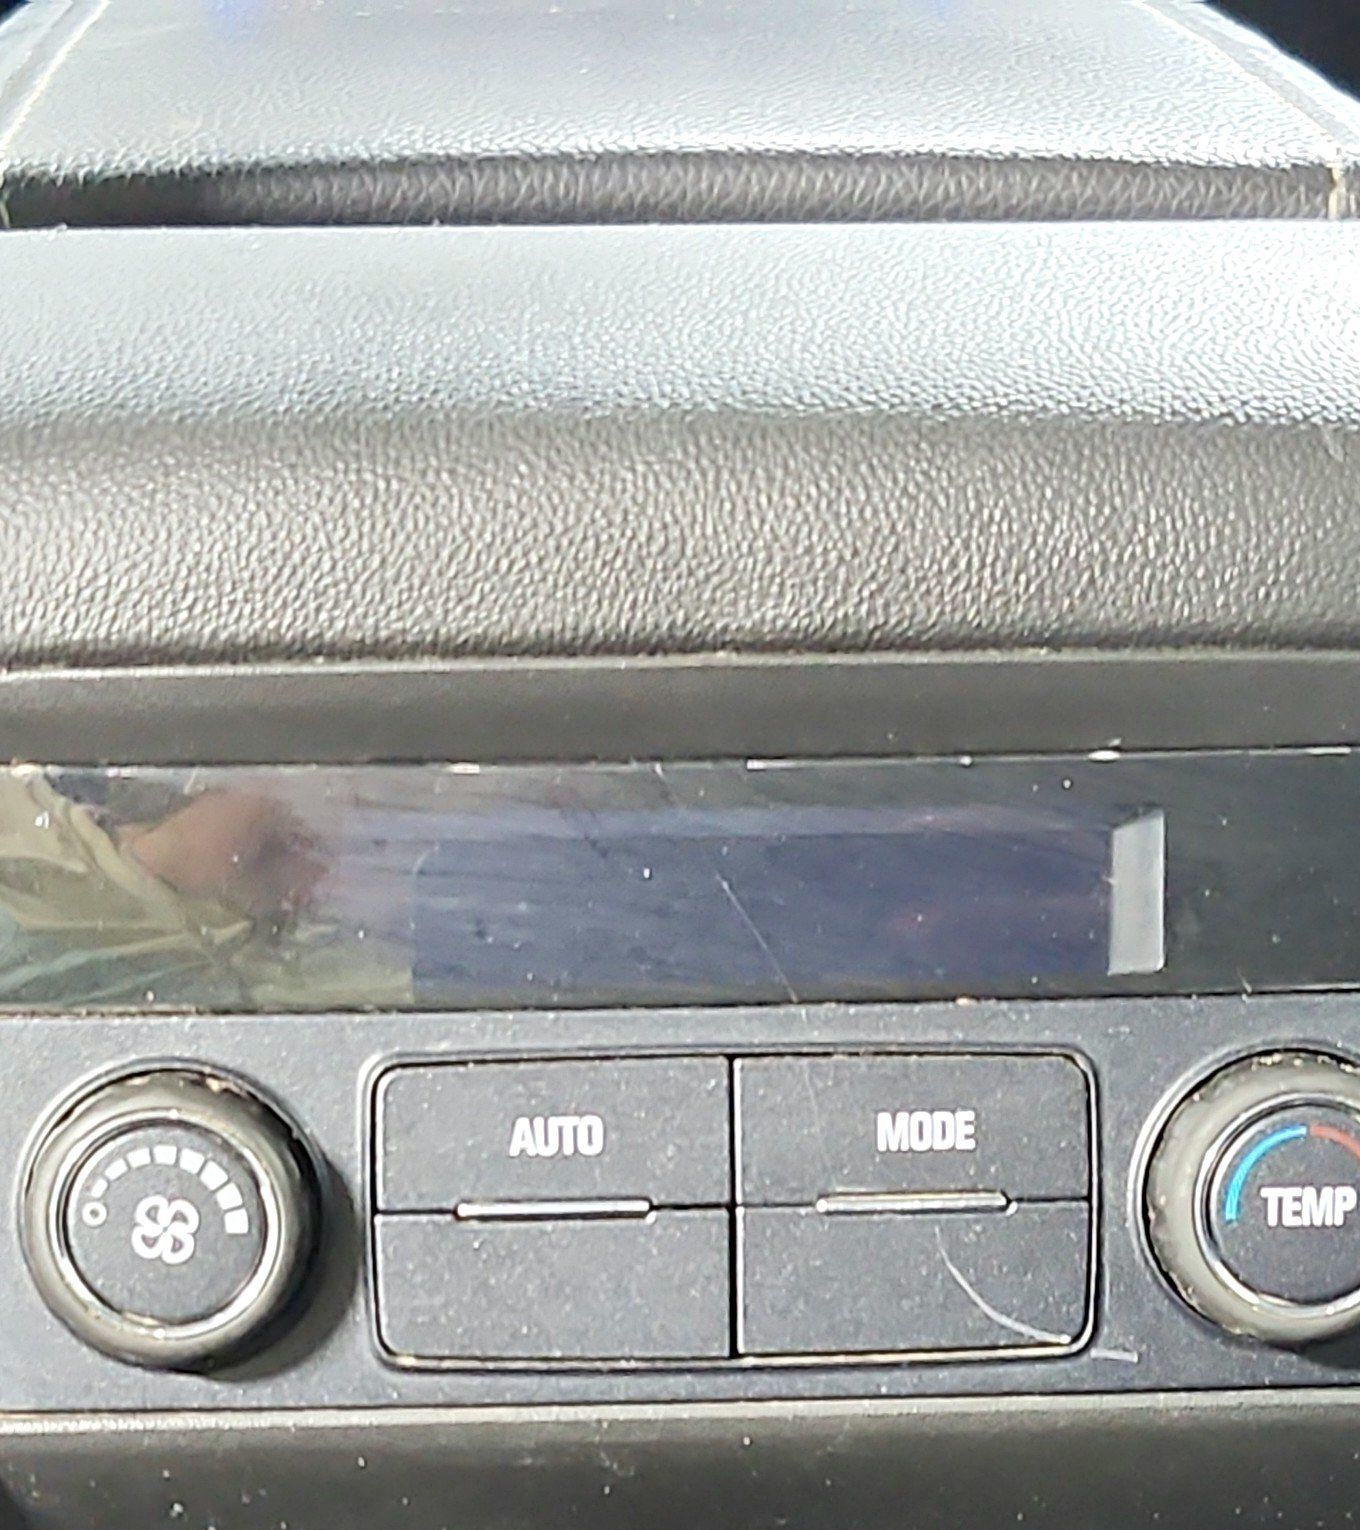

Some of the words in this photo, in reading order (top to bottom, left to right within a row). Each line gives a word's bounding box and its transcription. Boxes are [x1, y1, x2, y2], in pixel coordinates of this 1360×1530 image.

[508, 1114, 605, 1157] AUTO
[876, 1110, 977, 1152] MODE
[1259, 1185, 1358, 1228] TEMP
